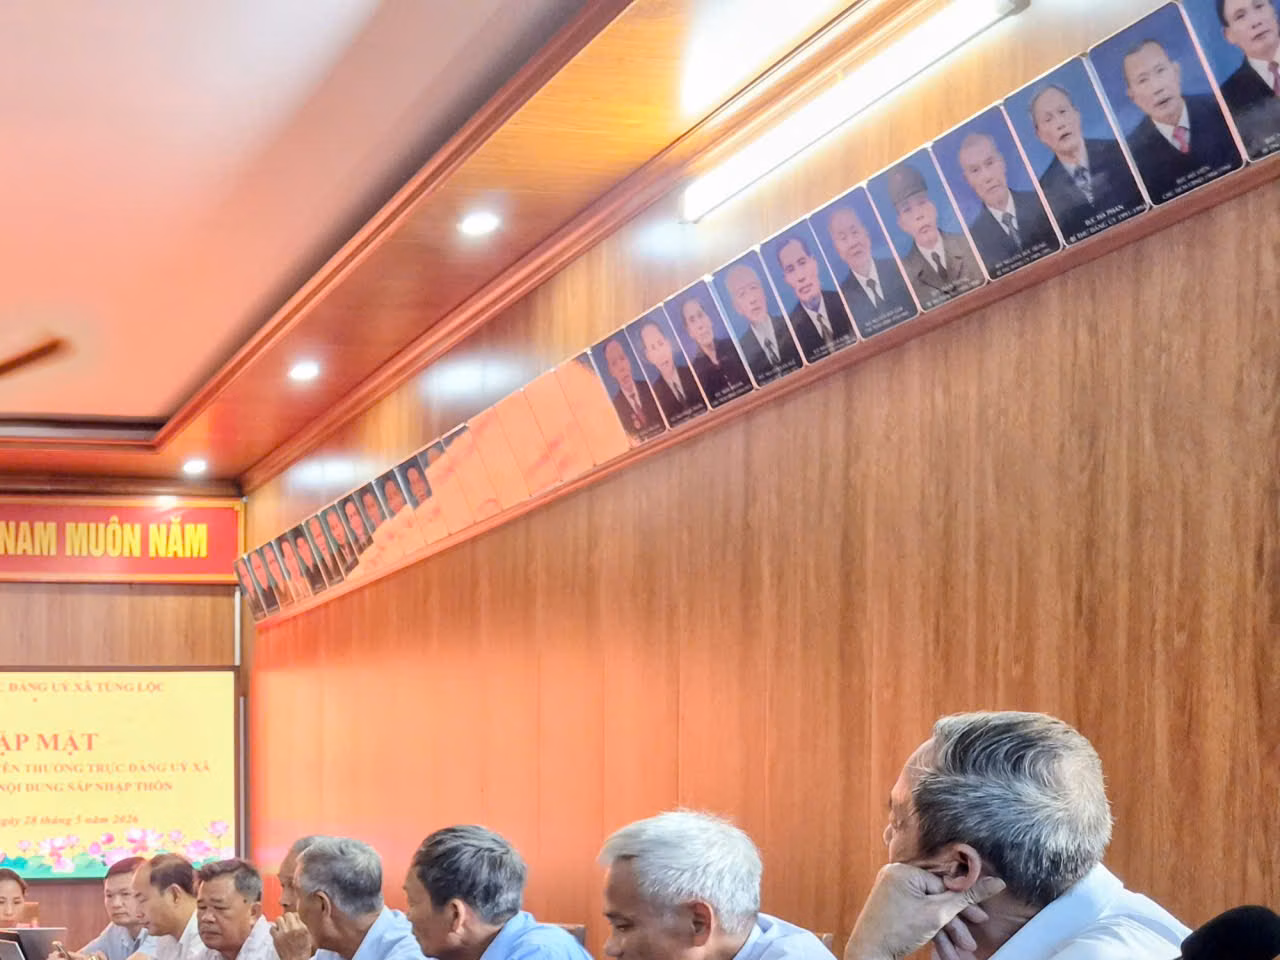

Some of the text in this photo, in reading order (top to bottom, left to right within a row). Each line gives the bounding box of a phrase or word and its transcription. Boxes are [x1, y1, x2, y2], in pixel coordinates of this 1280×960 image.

[65, 515, 141, 557] MUÔN
[148, 516, 208, 558] NĂM
[137, 680, 165, 694] LỘC
[36, 730, 99, 756] MẶT
[25, 783, 64, 793] DUNG
[136, 779, 173, 792] THÔN
